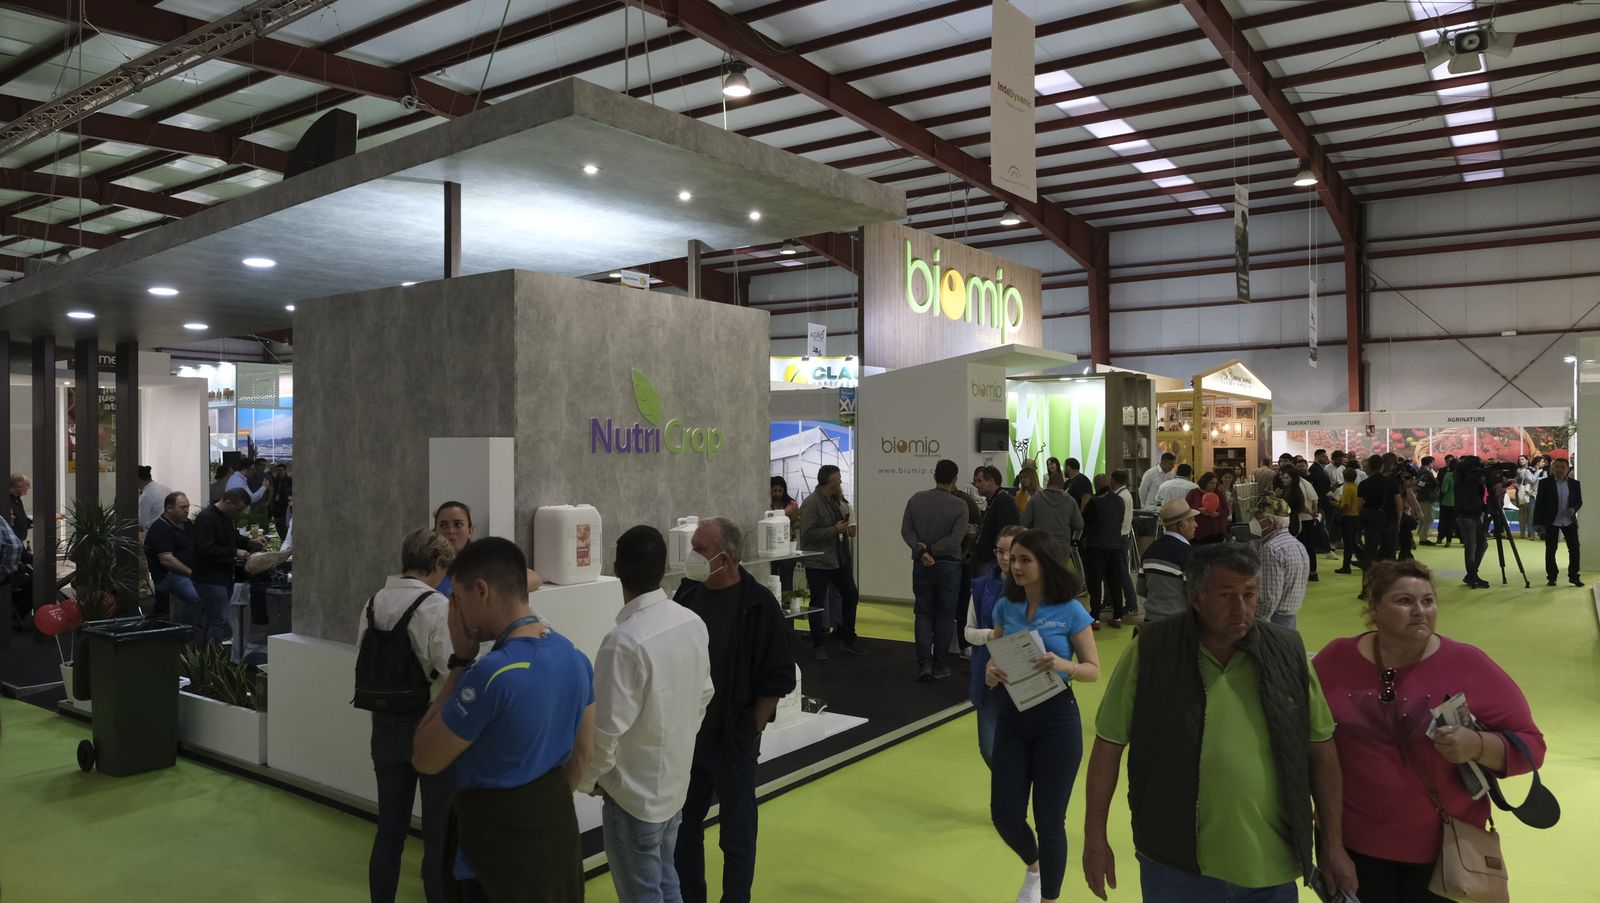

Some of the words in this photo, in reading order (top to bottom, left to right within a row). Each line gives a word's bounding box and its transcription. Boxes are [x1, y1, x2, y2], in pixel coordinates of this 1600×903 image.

[905, 239, 1023, 344] biomip
[812, 366, 858, 381] CLA
[971, 379, 1003, 399] biomip
[881, 436, 941, 457] biomip
[878, 466, 935, 475] www.biomip.c
